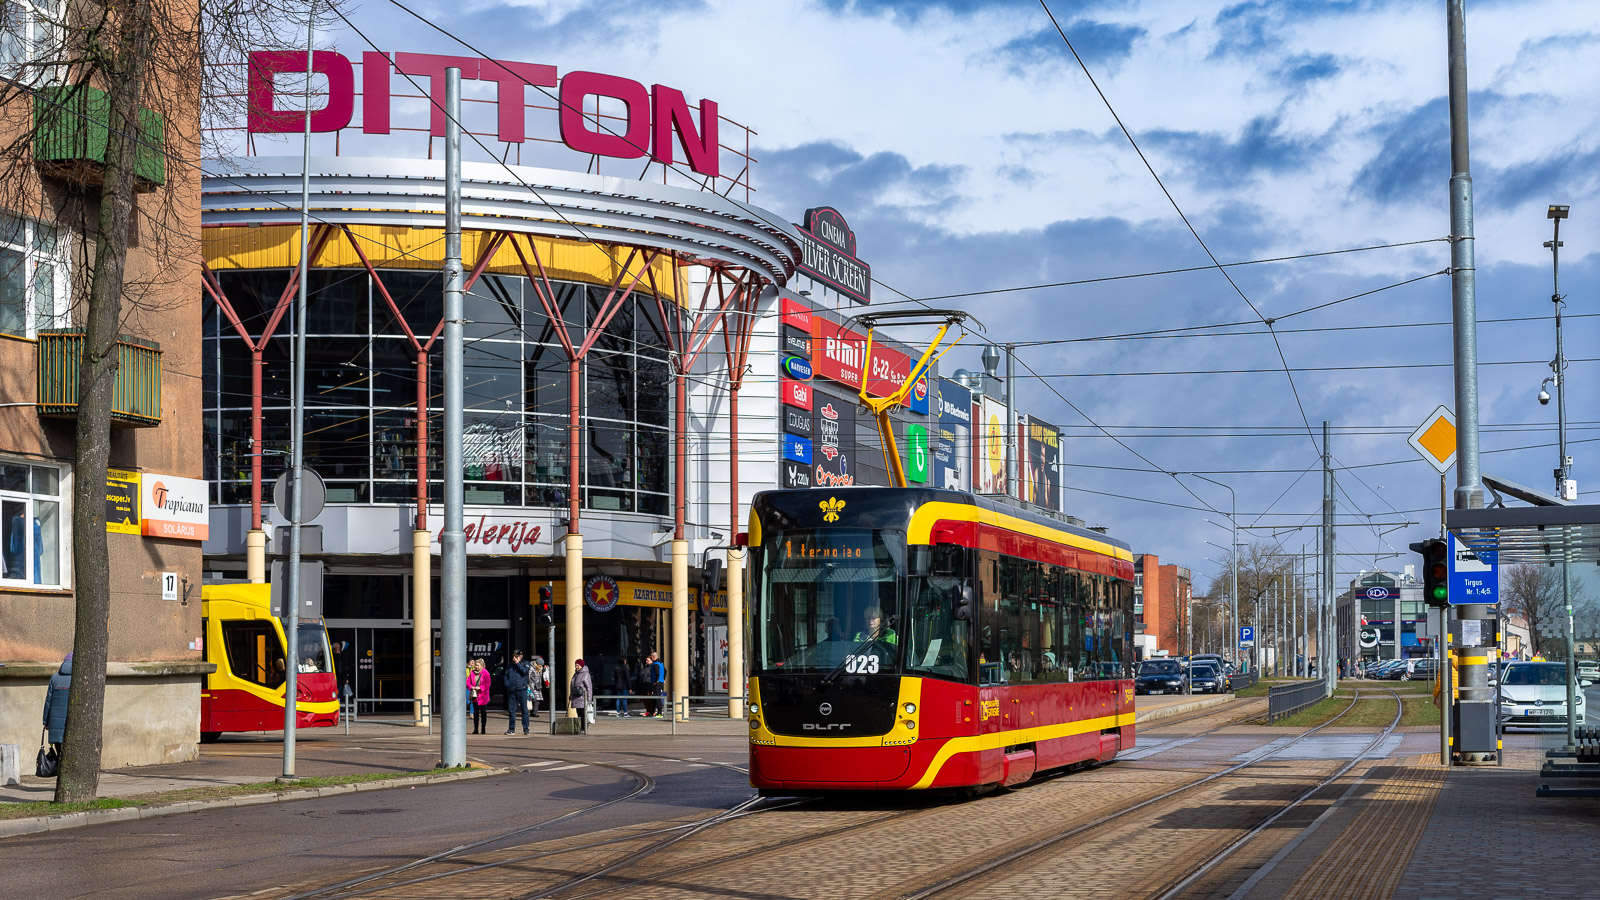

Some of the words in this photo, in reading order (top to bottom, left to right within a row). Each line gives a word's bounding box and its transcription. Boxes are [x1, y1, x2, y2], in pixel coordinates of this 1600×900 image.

[248, 50, 719, 178] DITTON
[821, 220, 846, 249] CINEMA
[832, 253, 867, 295] SCREEN
[826, 333, 859, 369] Rimi
[790, 361, 811, 376] NARVESEN
[840, 368, 858, 383] SUPER
[872, 356, 889, 380] 8-22
[793, 384, 807, 403] Gabi
[916, 382, 927, 395] PEPCO
[944, 400, 950, 414] RD
[950, 403, 970, 421] Electronics
[789, 412, 810, 432] DOUGLAS
[156, 487, 204, 515] Tropicana
[163, 523, 195, 536] SOLĀRIJS
[165, 575, 174, 592] 17
[1464, 579, 1483, 588] Tirgus
[633, 588, 657, 601] AZARTA
[657, 590, 673, 603] KLUB
[711, 592, 728, 609] KLON
[1369, 589, 1387, 597] RDA
[1243, 628, 1251, 639] P
[465, 642, 492, 652] imi
[845, 654, 880, 674] 023
